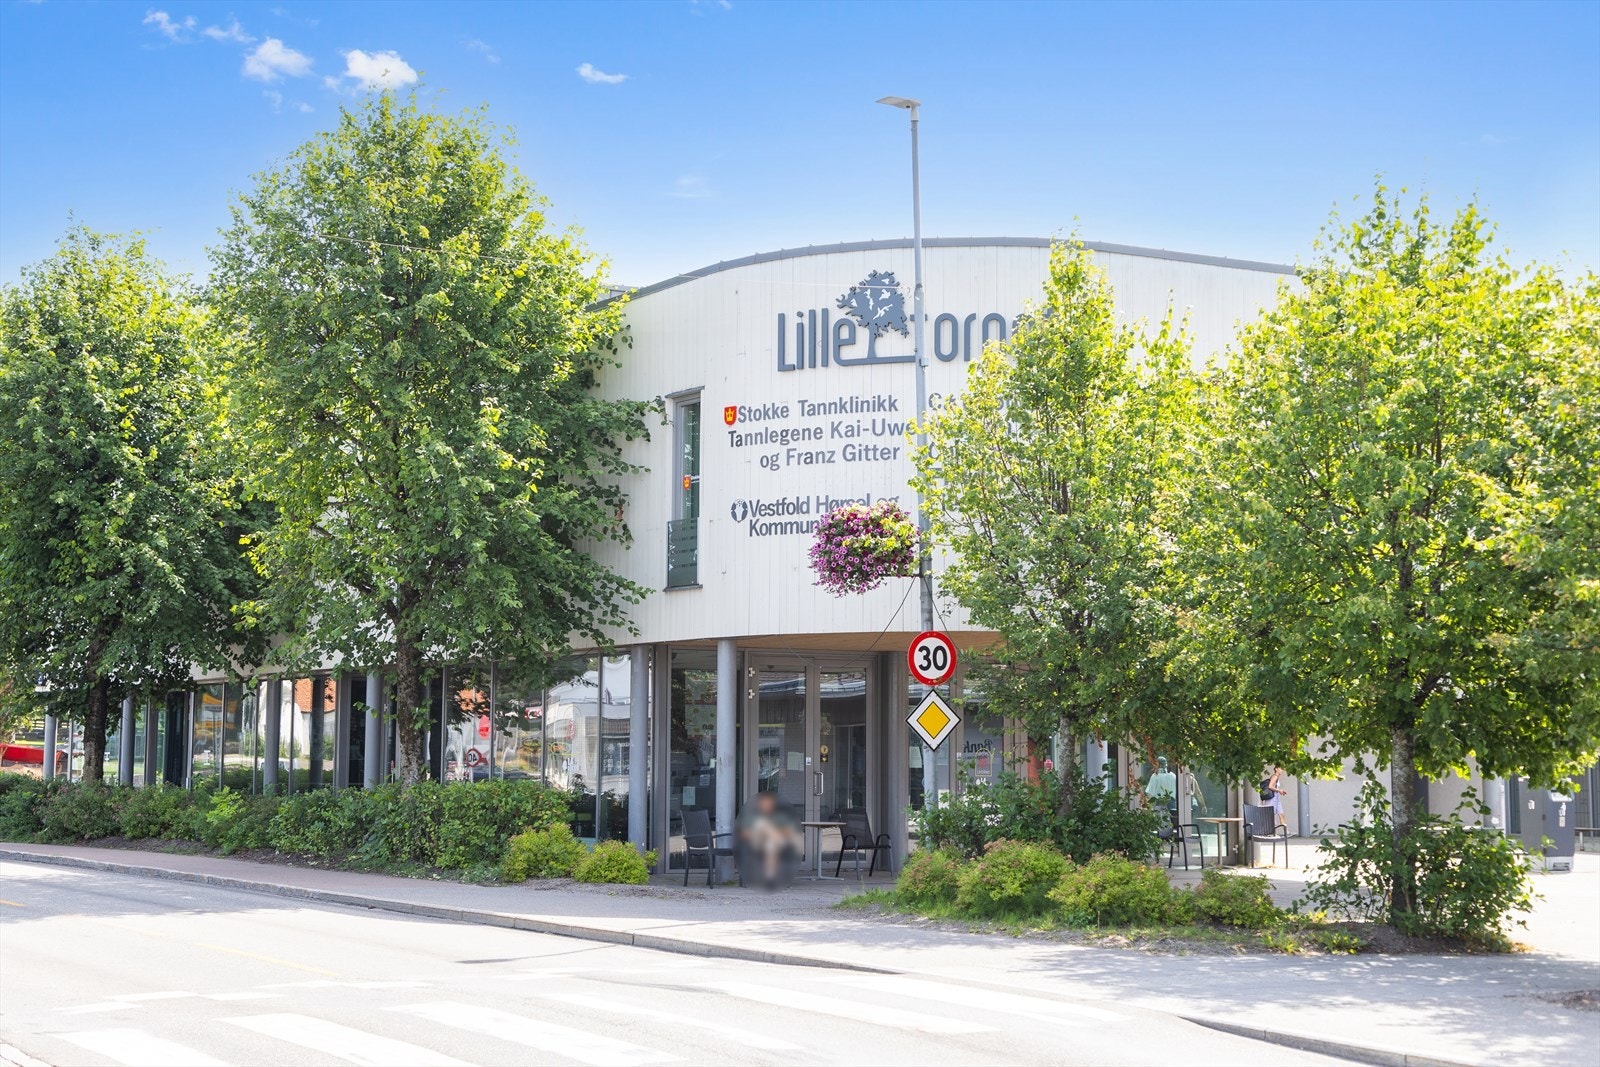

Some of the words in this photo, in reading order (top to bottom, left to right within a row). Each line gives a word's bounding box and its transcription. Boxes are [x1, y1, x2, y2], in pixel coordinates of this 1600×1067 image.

[778, 307, 856, 372] Lille
[738, 402, 789, 424] Stokke
[798, 395, 899, 417] Tannklinikk
[728, 426, 824, 447] Tannlegene
[760, 452, 780, 471] og
[786, 448, 836, 467] Franz
[842, 443, 900, 462] Gitter
[749, 495, 811, 518] Vestfold
[918, 645, 948, 671] 30
